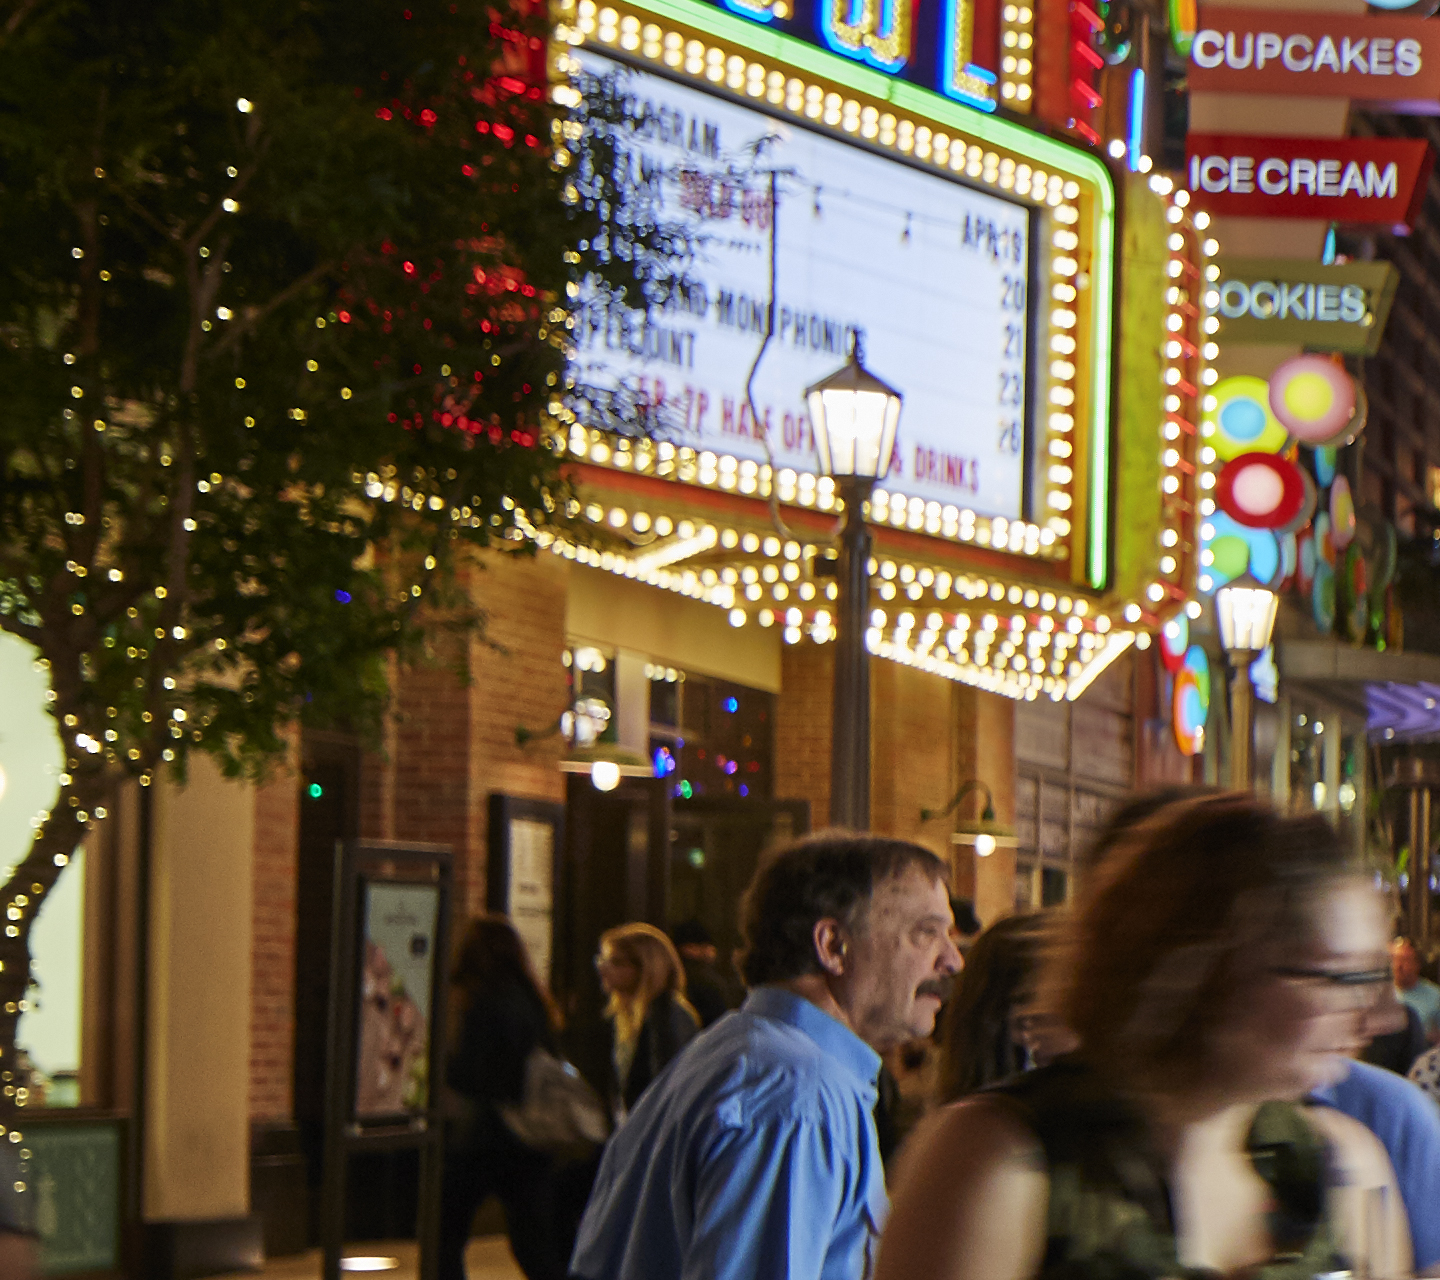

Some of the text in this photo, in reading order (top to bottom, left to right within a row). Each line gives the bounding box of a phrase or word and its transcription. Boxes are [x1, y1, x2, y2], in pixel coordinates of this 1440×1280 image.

[1190, 29, 1422, 77] CUPCAKES
[1189, 154, 1398, 198] ICE CREAM
[1001, 275, 1025, 312] 20
[1003, 323, 1024, 360] 21
[915, 442, 980, 495] DRINKS
